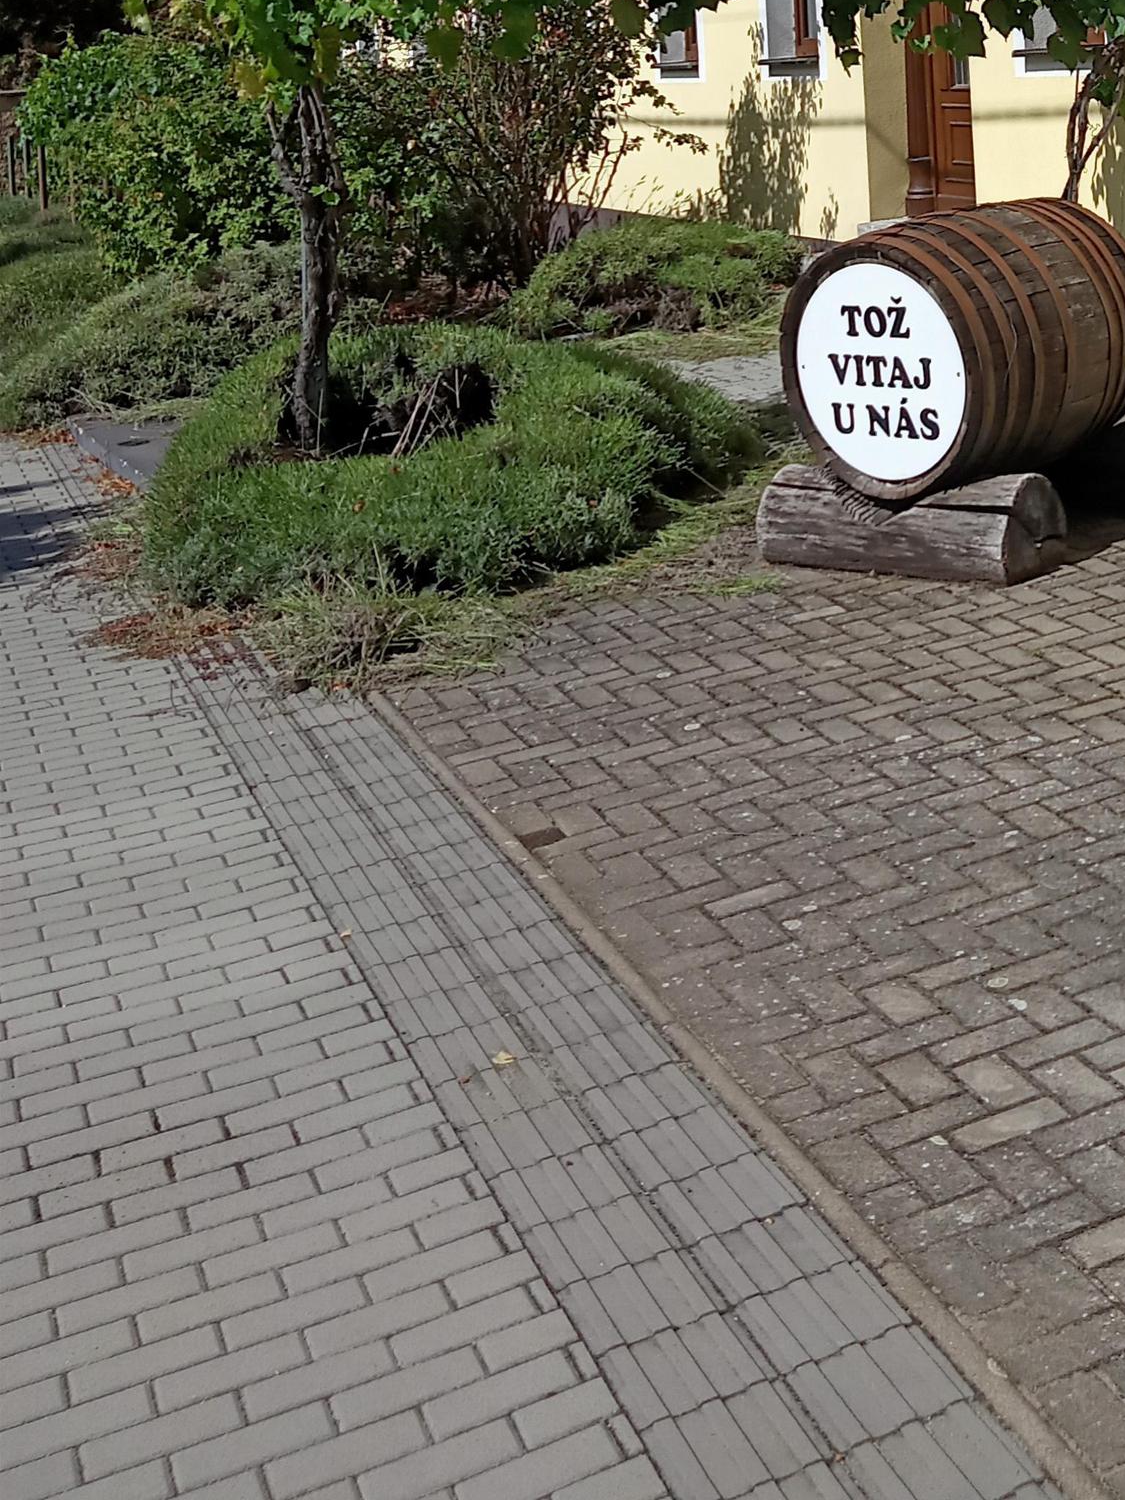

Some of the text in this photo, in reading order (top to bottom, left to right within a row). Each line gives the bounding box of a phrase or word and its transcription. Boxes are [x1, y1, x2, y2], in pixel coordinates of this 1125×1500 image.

[841, 296, 910, 339] TOŽ
[828, 353, 932, 390] VITAJ
[831, 397, 940, 440] U NÁS
